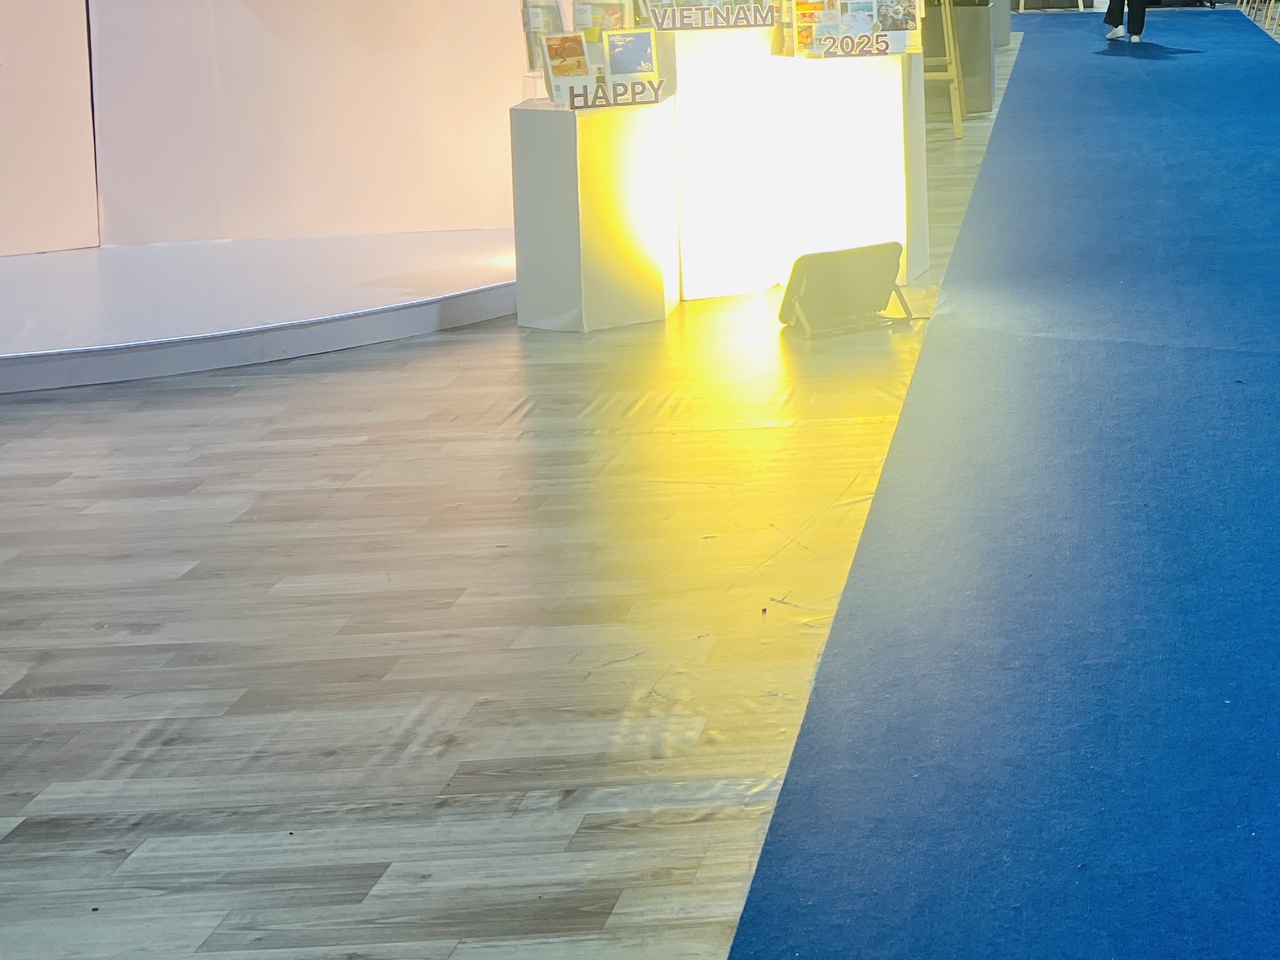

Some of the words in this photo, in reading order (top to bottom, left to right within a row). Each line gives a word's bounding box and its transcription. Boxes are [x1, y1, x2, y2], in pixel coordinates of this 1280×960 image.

[650, 4, 775, 31] VIETNAM
[821, 34, 890, 58] 2025
[569, 80, 664, 110] HAPPY
